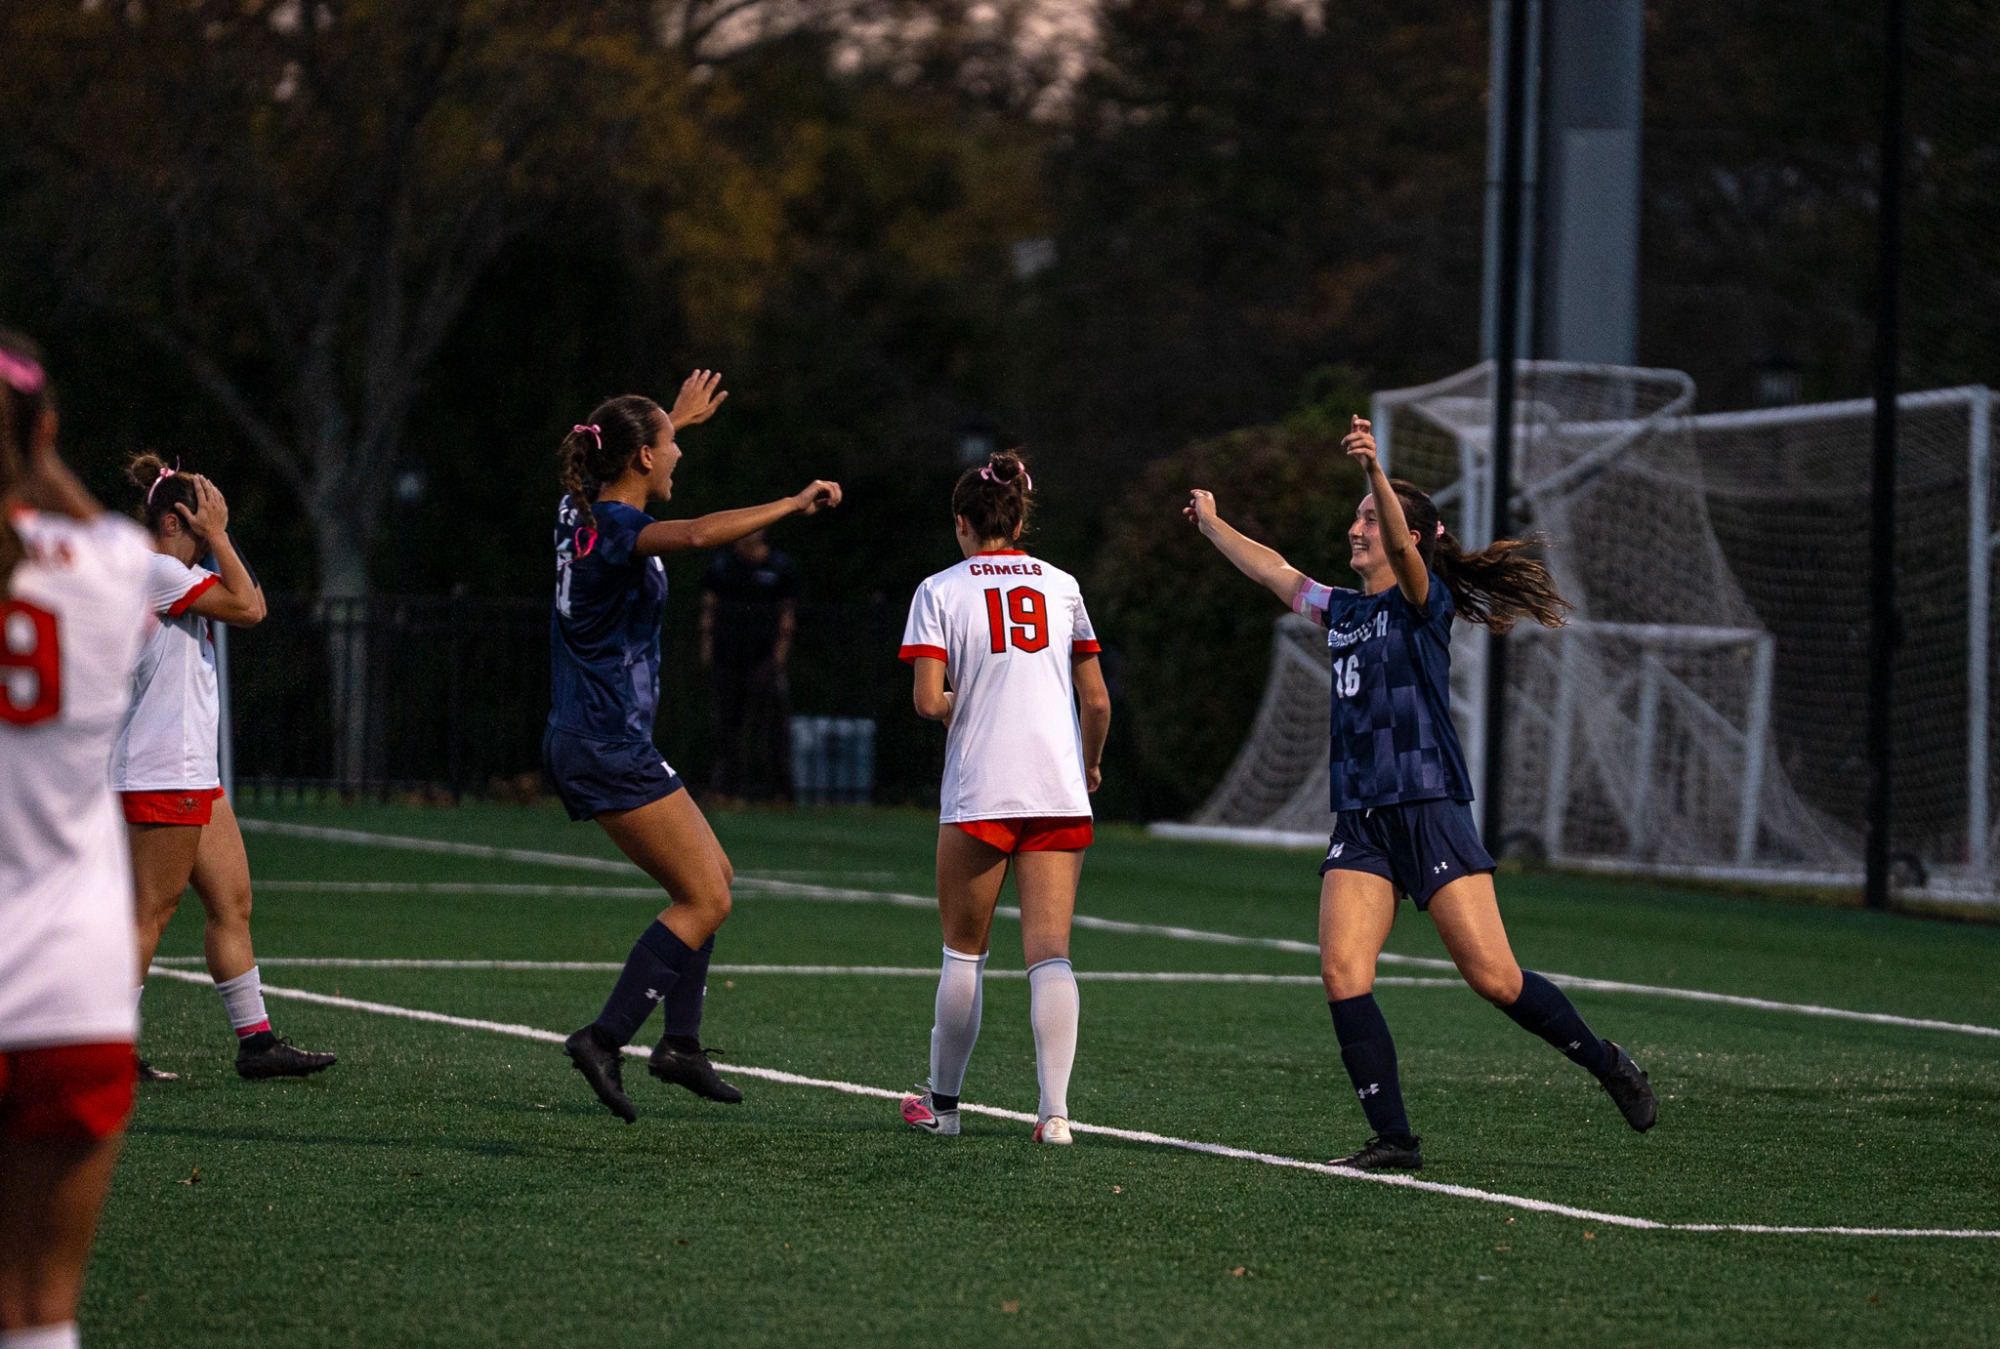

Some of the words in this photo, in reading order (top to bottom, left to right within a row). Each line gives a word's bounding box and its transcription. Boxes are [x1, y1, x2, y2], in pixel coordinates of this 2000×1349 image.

[969, 563, 1043, 576] CAMELS
[984, 585, 1049, 654] 19
[1333, 654, 1361, 699] 16
